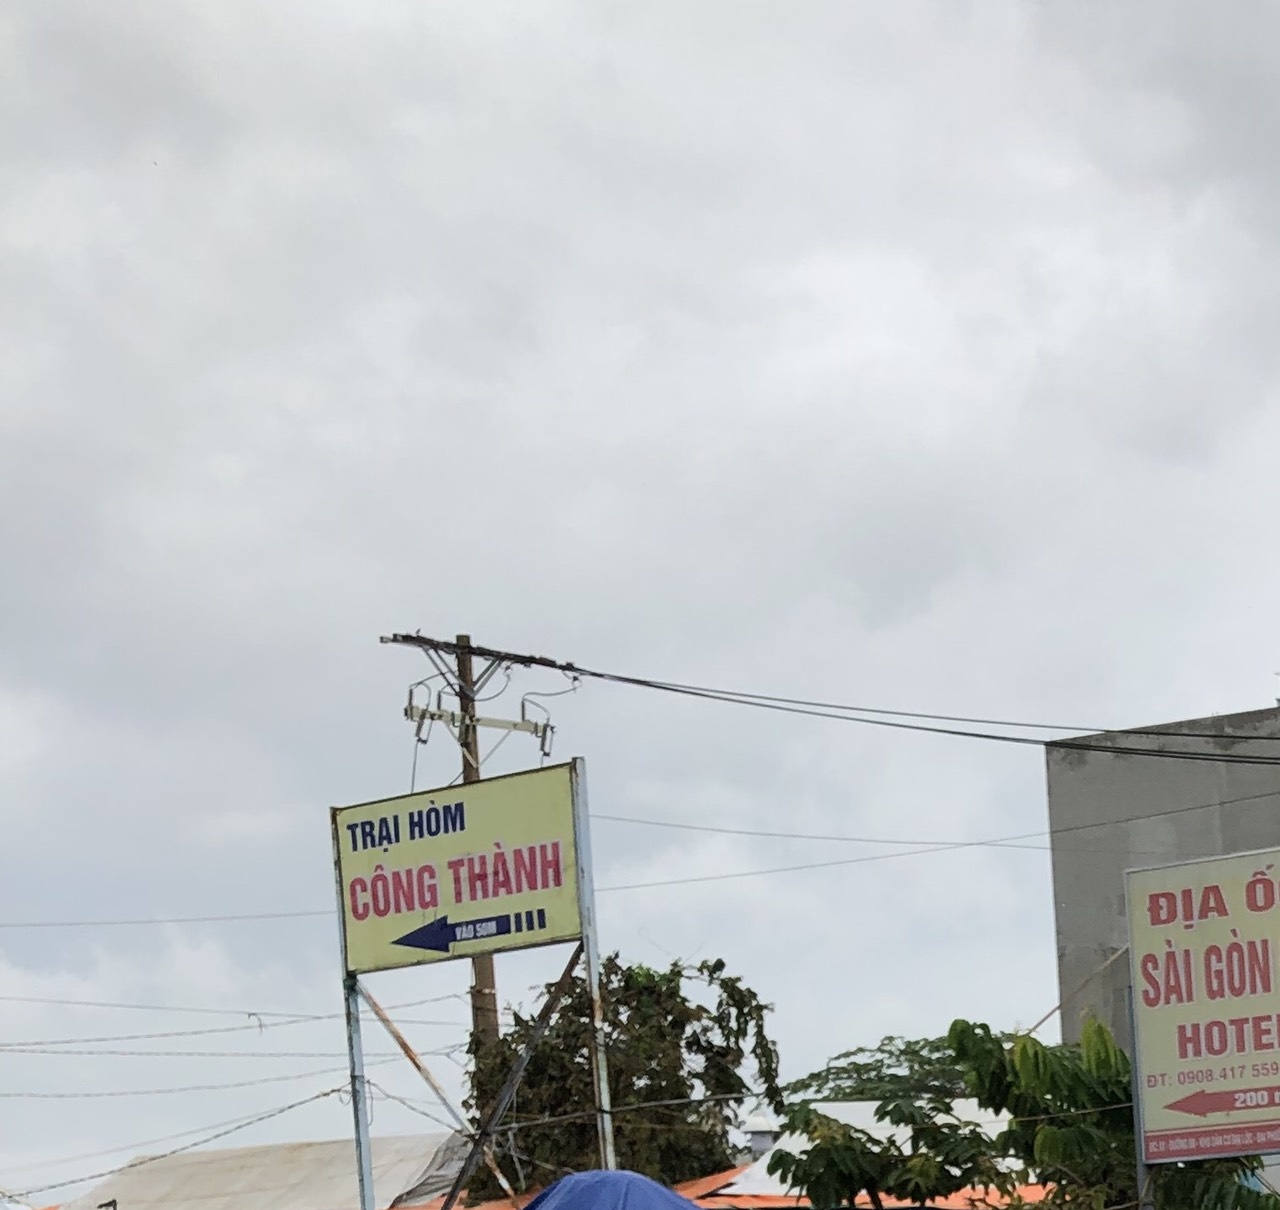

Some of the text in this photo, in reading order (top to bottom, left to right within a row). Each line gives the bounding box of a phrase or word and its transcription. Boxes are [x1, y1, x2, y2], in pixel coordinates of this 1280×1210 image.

[346, 800, 466, 853] TRẠI HÒM
[349, 841, 563, 921] CÔNG THÀNH
[1147, 884, 1229, 931] ĐỊA
[1140, 938, 1195, 1008] SÀI
[1203, 928, 1272, 1001] GÒN
[1252, 1060, 1280, 1078] 559
[1234, 1089, 1269, 1108] 200
